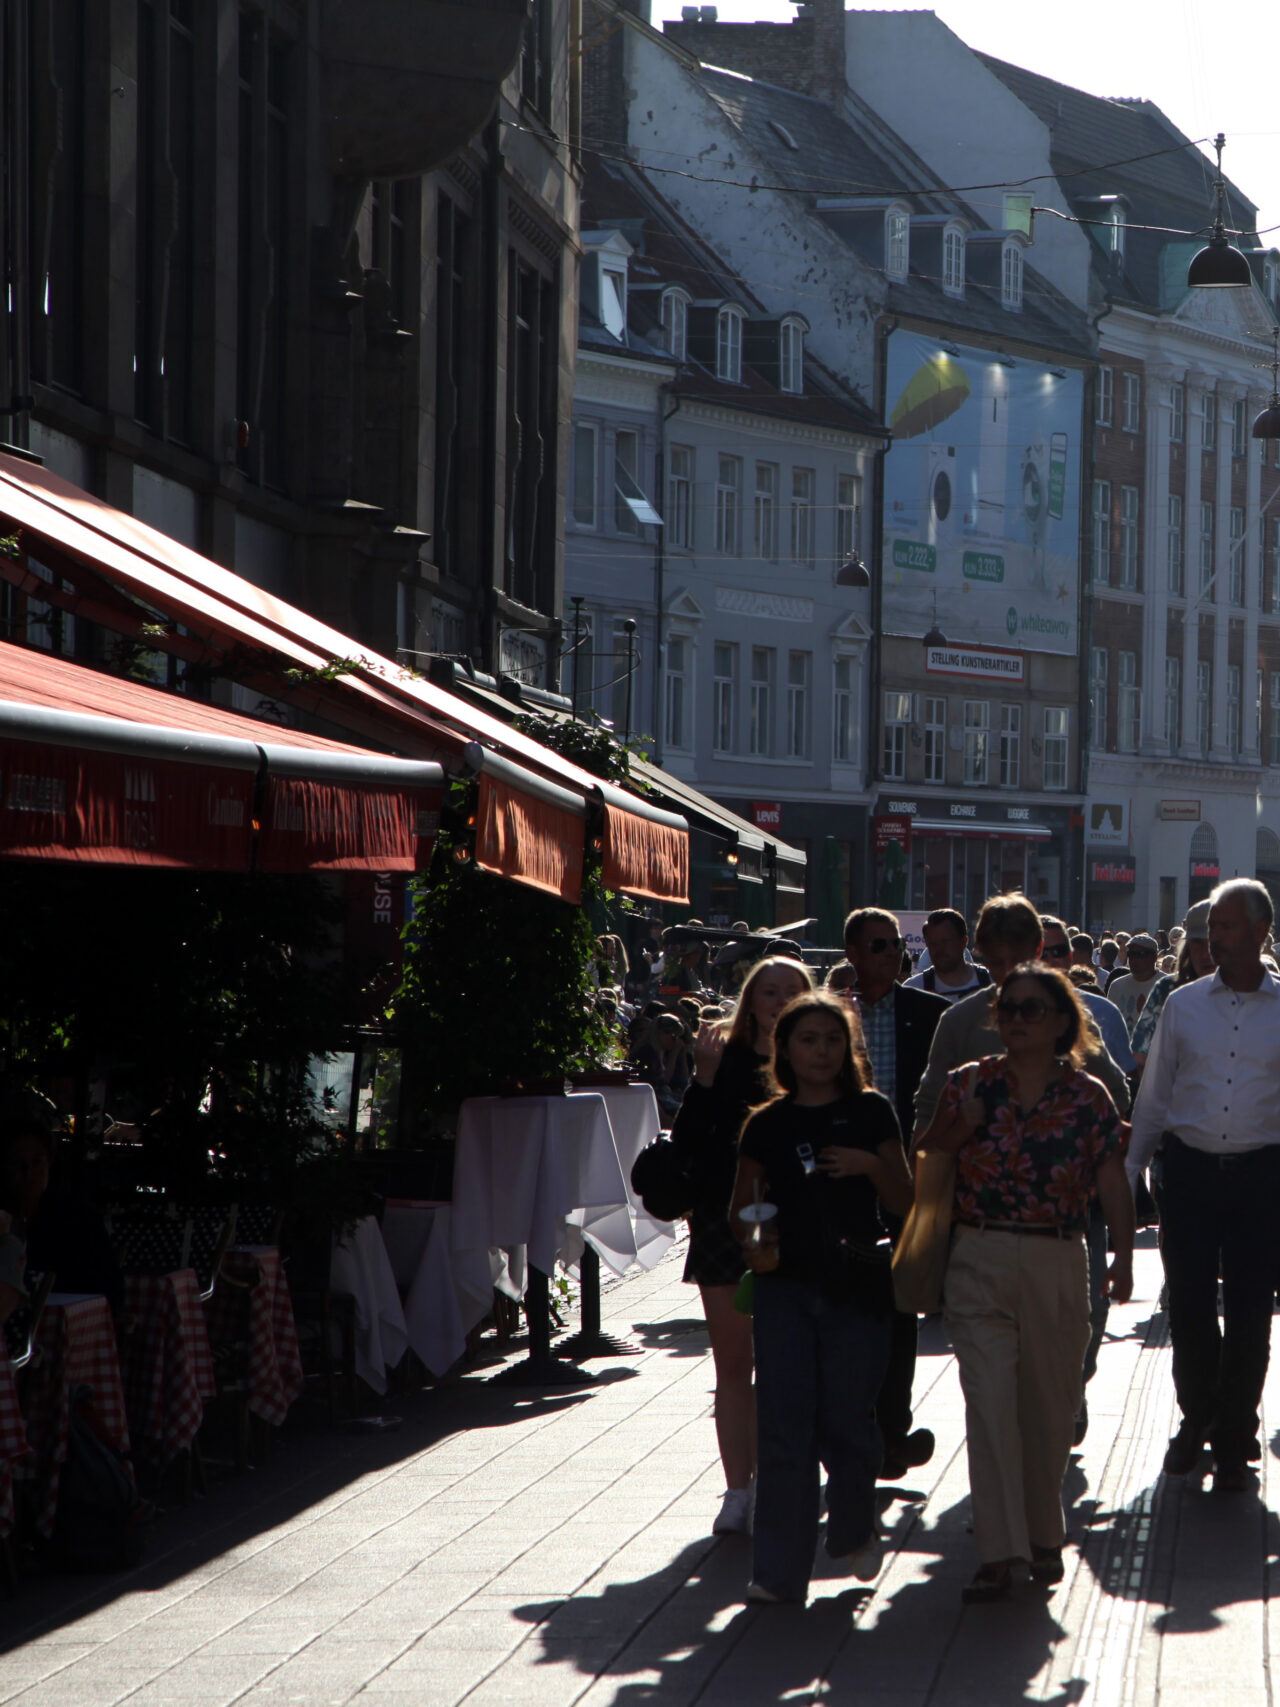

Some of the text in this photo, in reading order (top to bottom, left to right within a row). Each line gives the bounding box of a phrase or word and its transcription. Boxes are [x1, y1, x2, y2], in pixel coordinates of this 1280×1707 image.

[1021, 613, 1071, 639] whiteaway
[931, 651, 1020, 674] STELLING KUNSTNERARTIKLER
[950, 804, 977, 817] EXCHANGE
[1007, 807, 1030, 821] LUGGAGE
[373, 873, 392, 924] USE
